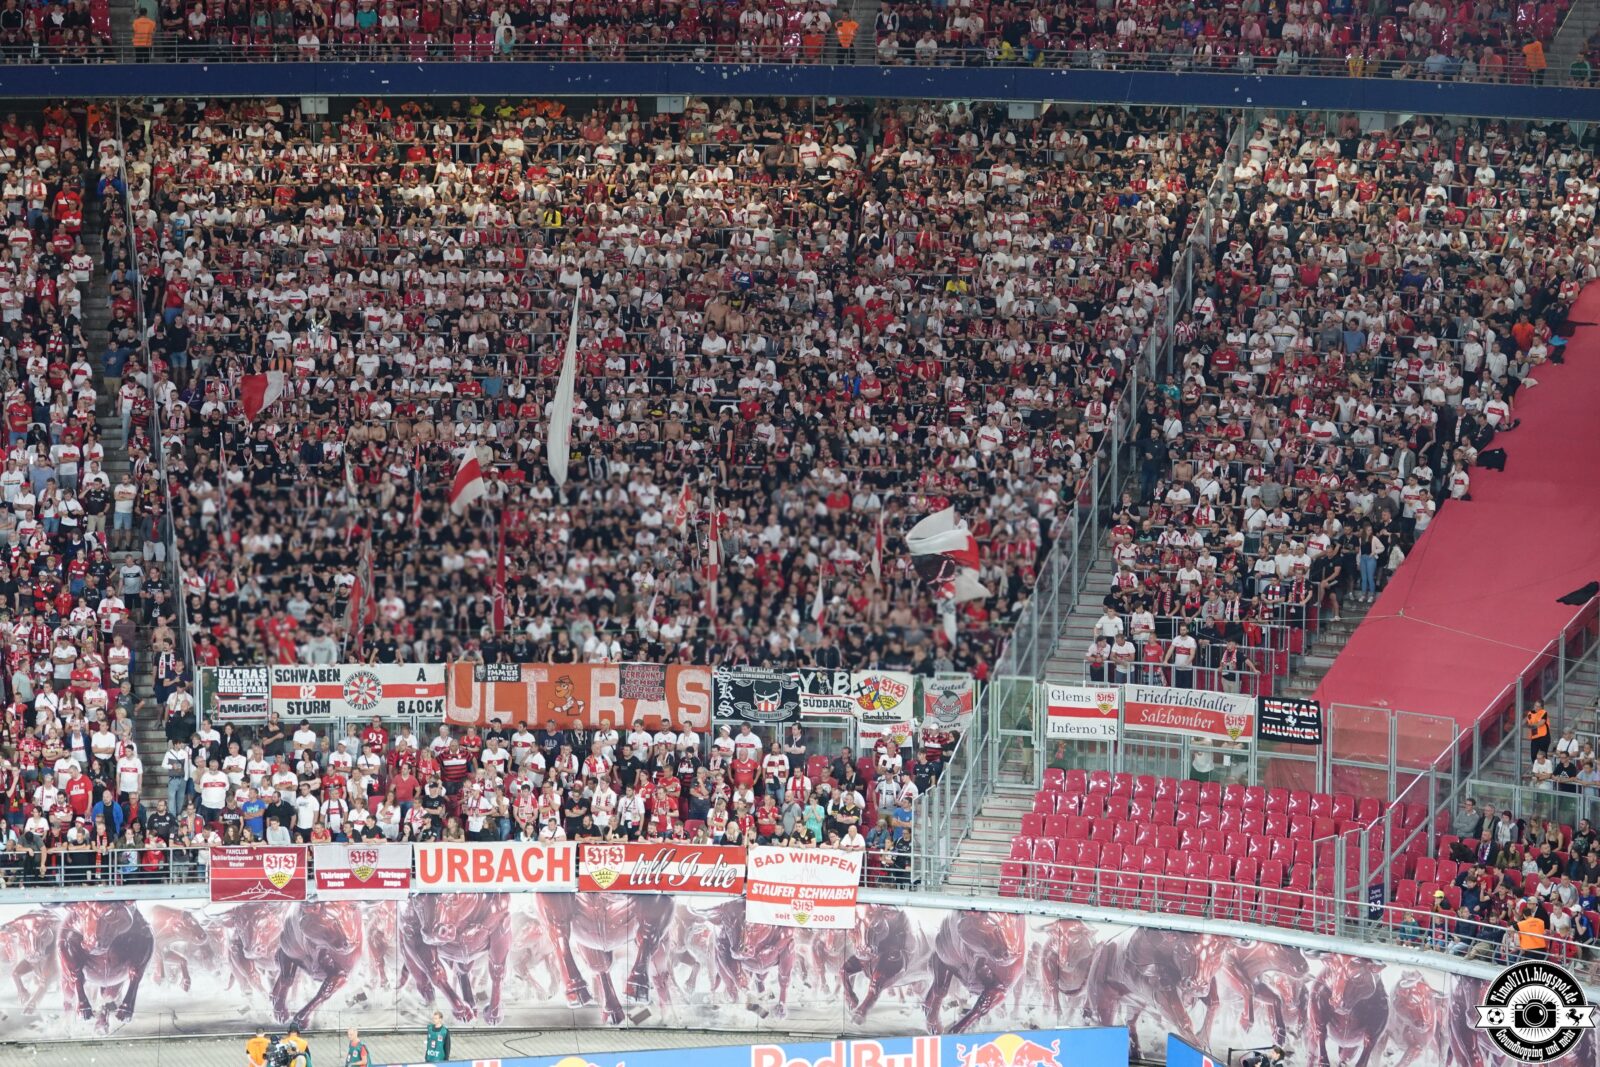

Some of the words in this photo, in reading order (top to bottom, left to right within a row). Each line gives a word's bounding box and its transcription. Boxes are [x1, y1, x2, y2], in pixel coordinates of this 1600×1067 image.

[219, 668, 267, 679] ULTRAS
[275, 668, 341, 683] SCHWABEN
[416, 667, 427, 682] A
[219, 679, 267, 687] BEDEUTET
[300, 685, 317, 699] 02
[1051, 690, 1091, 703] Glems
[287, 700, 331, 715] STURM
[398, 699, 444, 714] BLOCK
[1135, 689, 1237, 713] Friedrichshaller
[1264, 699, 1319, 718] NECKAR
[1140, 708, 1215, 729] Salzbomber
[1051, 722, 1098, 734] Inferno
[1262, 722, 1320, 740] HALUNKEN
[368, 732, 384, 745] 93
[265, 854, 297, 869] VfB
[350, 850, 378, 864] VfB
[587, 847, 625, 867] VfB
[753, 853, 785, 868] BAD
[789, 852, 857, 875] WIMPFEN
[419, 847, 571, 884] URBACH
[629, 847, 677, 886] till
[699, 853, 738, 889] die
[751, 882, 796, 898] STAUFER
[797, 886, 855, 900] SCHWABEN
[812, 914, 836, 922] 2008
